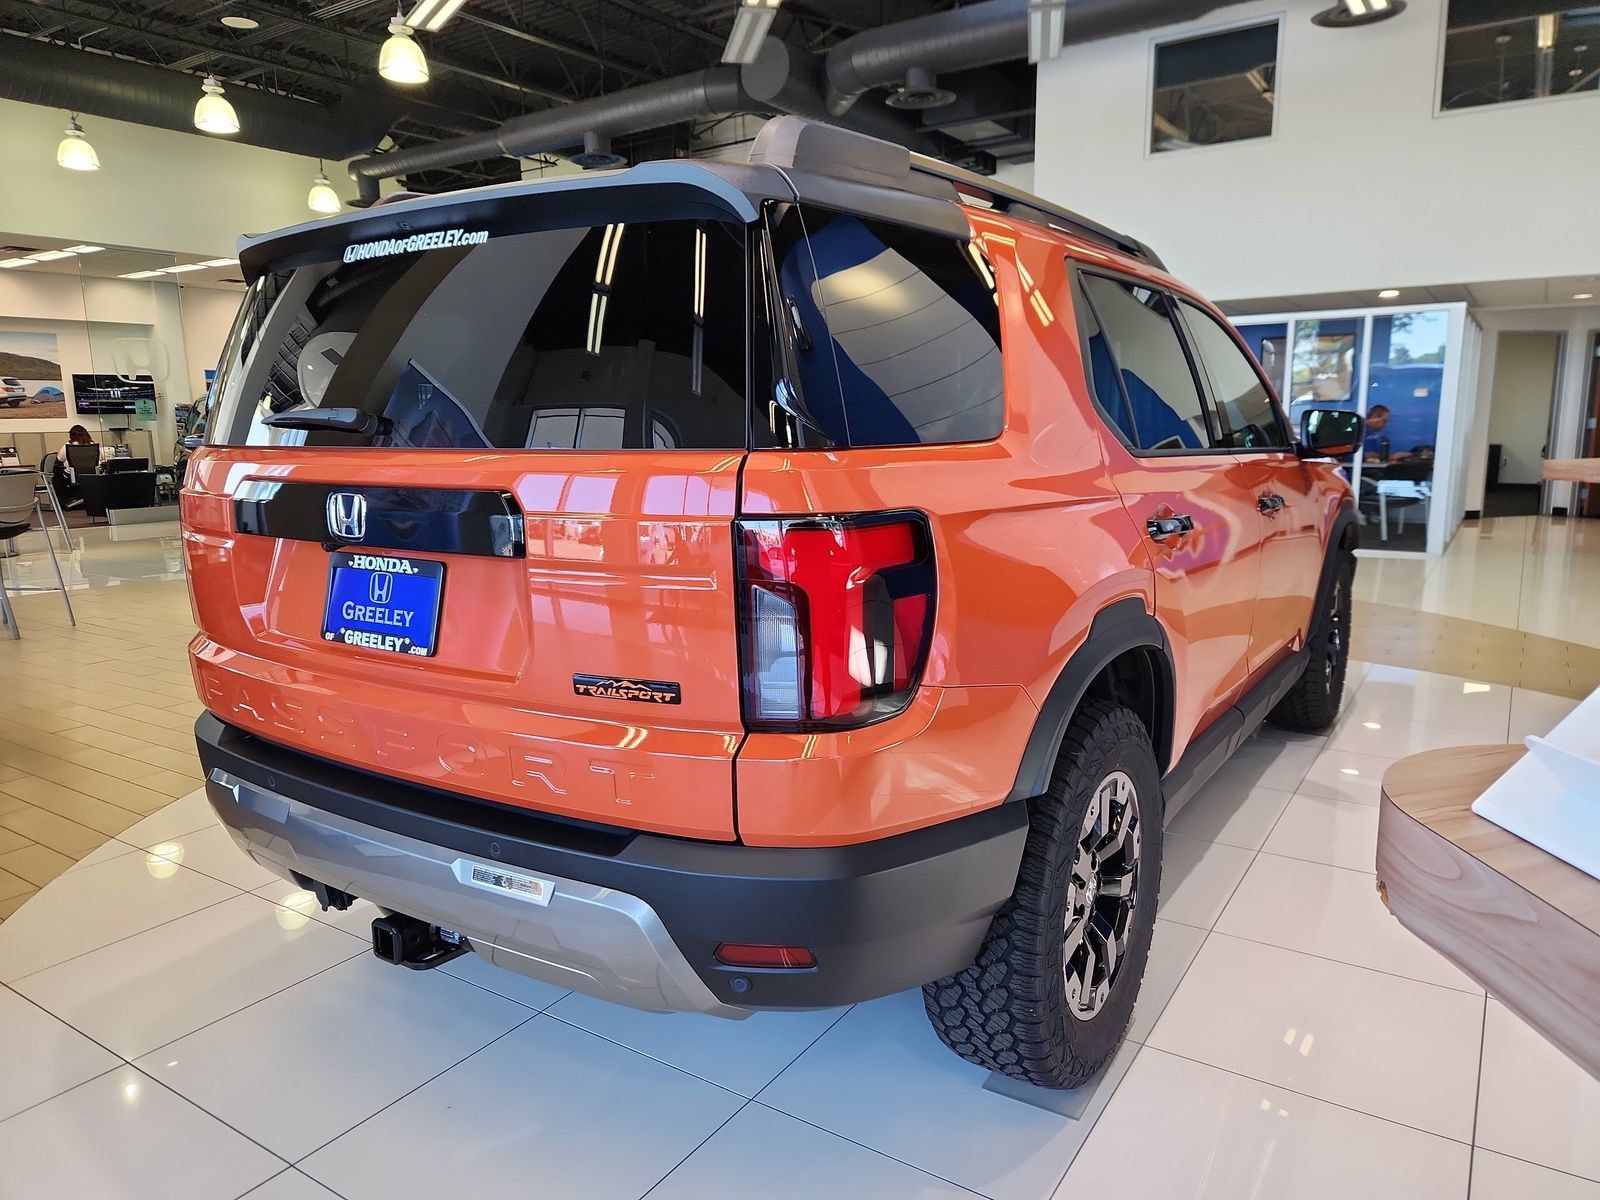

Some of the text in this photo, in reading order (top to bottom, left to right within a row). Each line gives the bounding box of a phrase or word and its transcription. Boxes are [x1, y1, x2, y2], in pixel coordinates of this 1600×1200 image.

[352, 555, 413, 574] HONDA
[342, 601, 414, 627] GREELEY
[325, 632, 335, 641] OF
[344, 630, 404, 653] GREELEY
[576, 684, 676, 703] TRAILSPORT
[202, 668, 655, 806] PASSPORT
